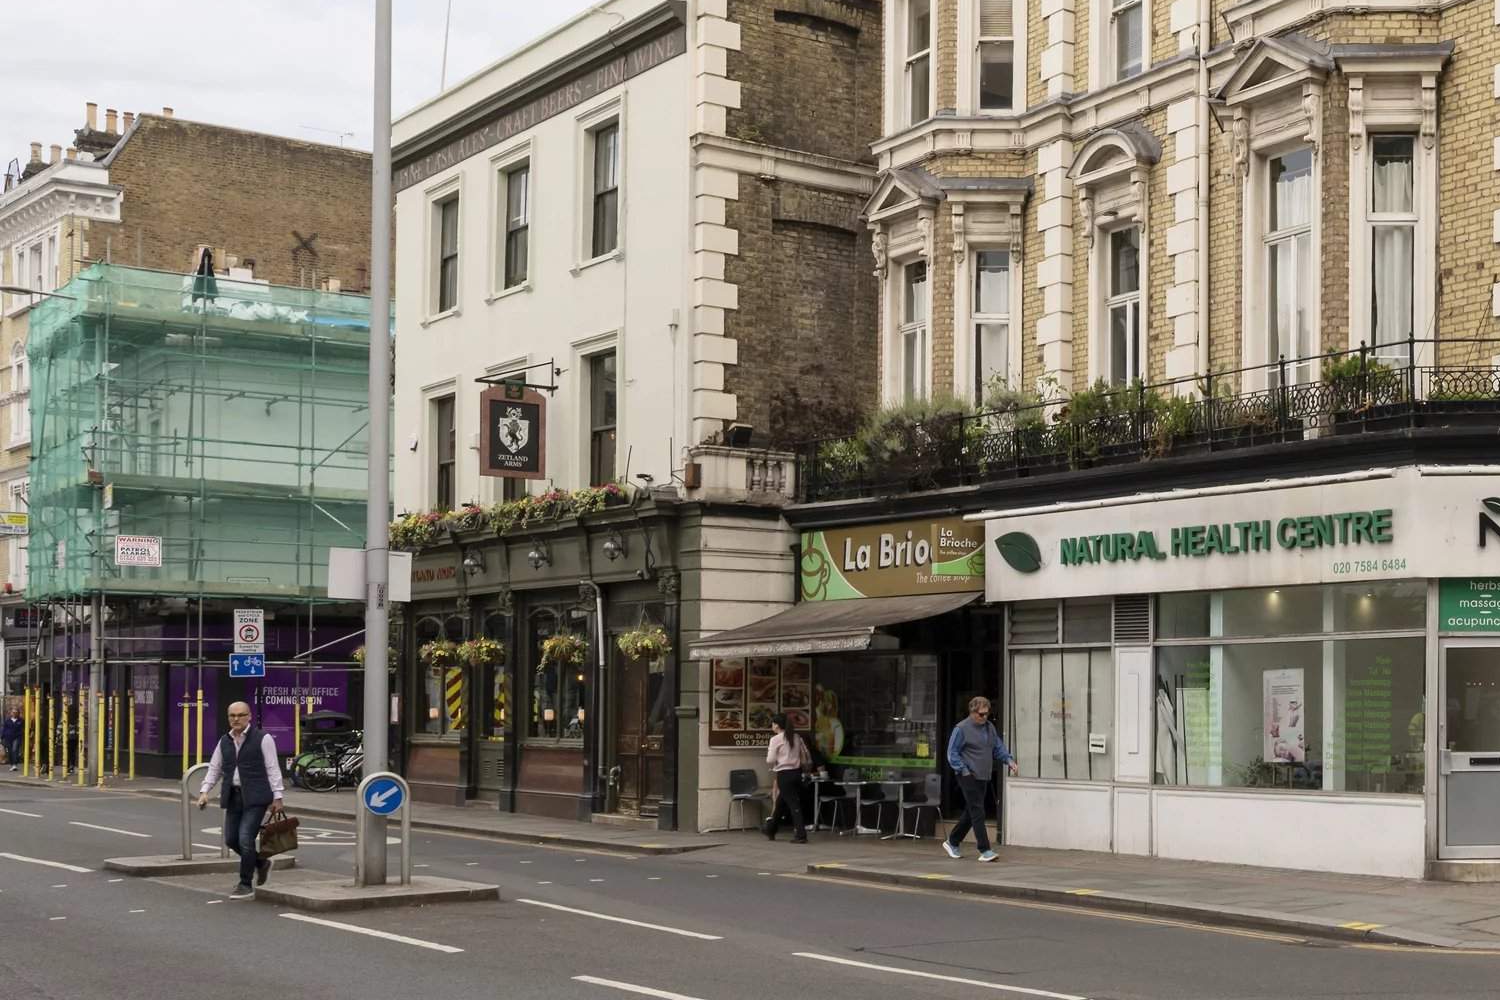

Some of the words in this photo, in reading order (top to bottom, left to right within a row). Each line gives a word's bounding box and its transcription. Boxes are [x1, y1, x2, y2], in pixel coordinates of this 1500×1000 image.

[498, 454, 528, 462] ZETLAND
[940, 527, 952, 537] La
[1060, 531, 1167, 567] NATURAL
[1170, 519, 1271, 557] HEALTH
[1276, 509, 1394, 550] CENTRE
[939, 537, 978, 549] Brioche
[843, 537, 870, 571] La
[879, 530, 933, 568] Brio
[1333, 561, 1351, 574] 020
[1354, 559, 1379, 573] 7584
[1381, 558, 1407, 571] 6484
[916, 572, 928, 584] The
[263, 686, 288, 696] FRESH
[291, 687, 309, 696] NEW
[312, 688, 339, 697] OFFICE
[265, 696, 297, 705] COMING
